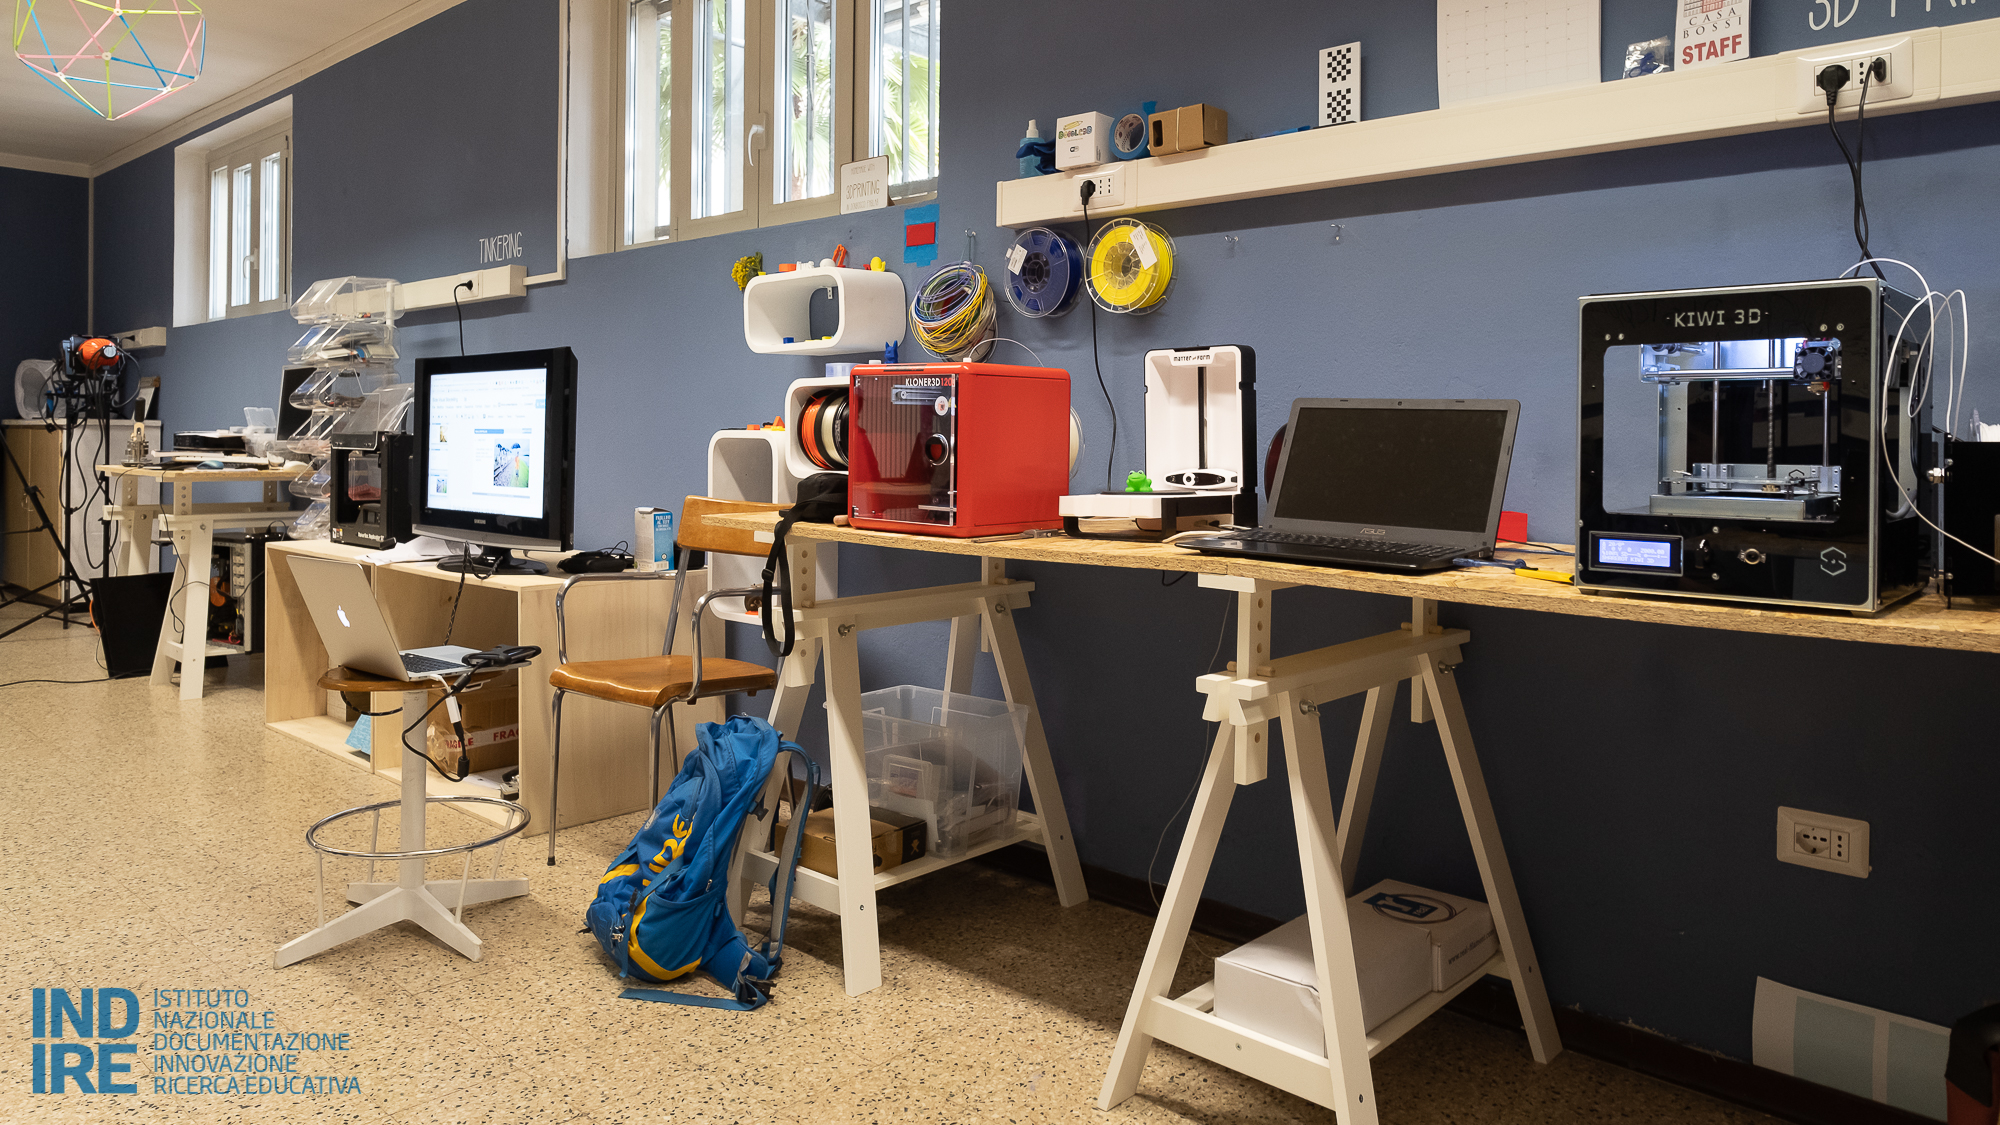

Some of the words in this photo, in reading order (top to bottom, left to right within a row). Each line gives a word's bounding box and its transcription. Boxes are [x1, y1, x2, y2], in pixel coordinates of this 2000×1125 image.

[1688, 7, 1737, 26] CASA
[1683, 16, 1742, 39] BOSSI
[1682, 33, 1743, 65] STAFF
[845, 179, 880, 200] 3DPRINTING
[479, 231, 523, 264] TINKERING
[1674, 310, 1725, 327] KIWI
[1734, 308, 1761, 325] 3D
[1359, 527, 1386, 536] ASUS
[493, 728, 519, 742] FRA
